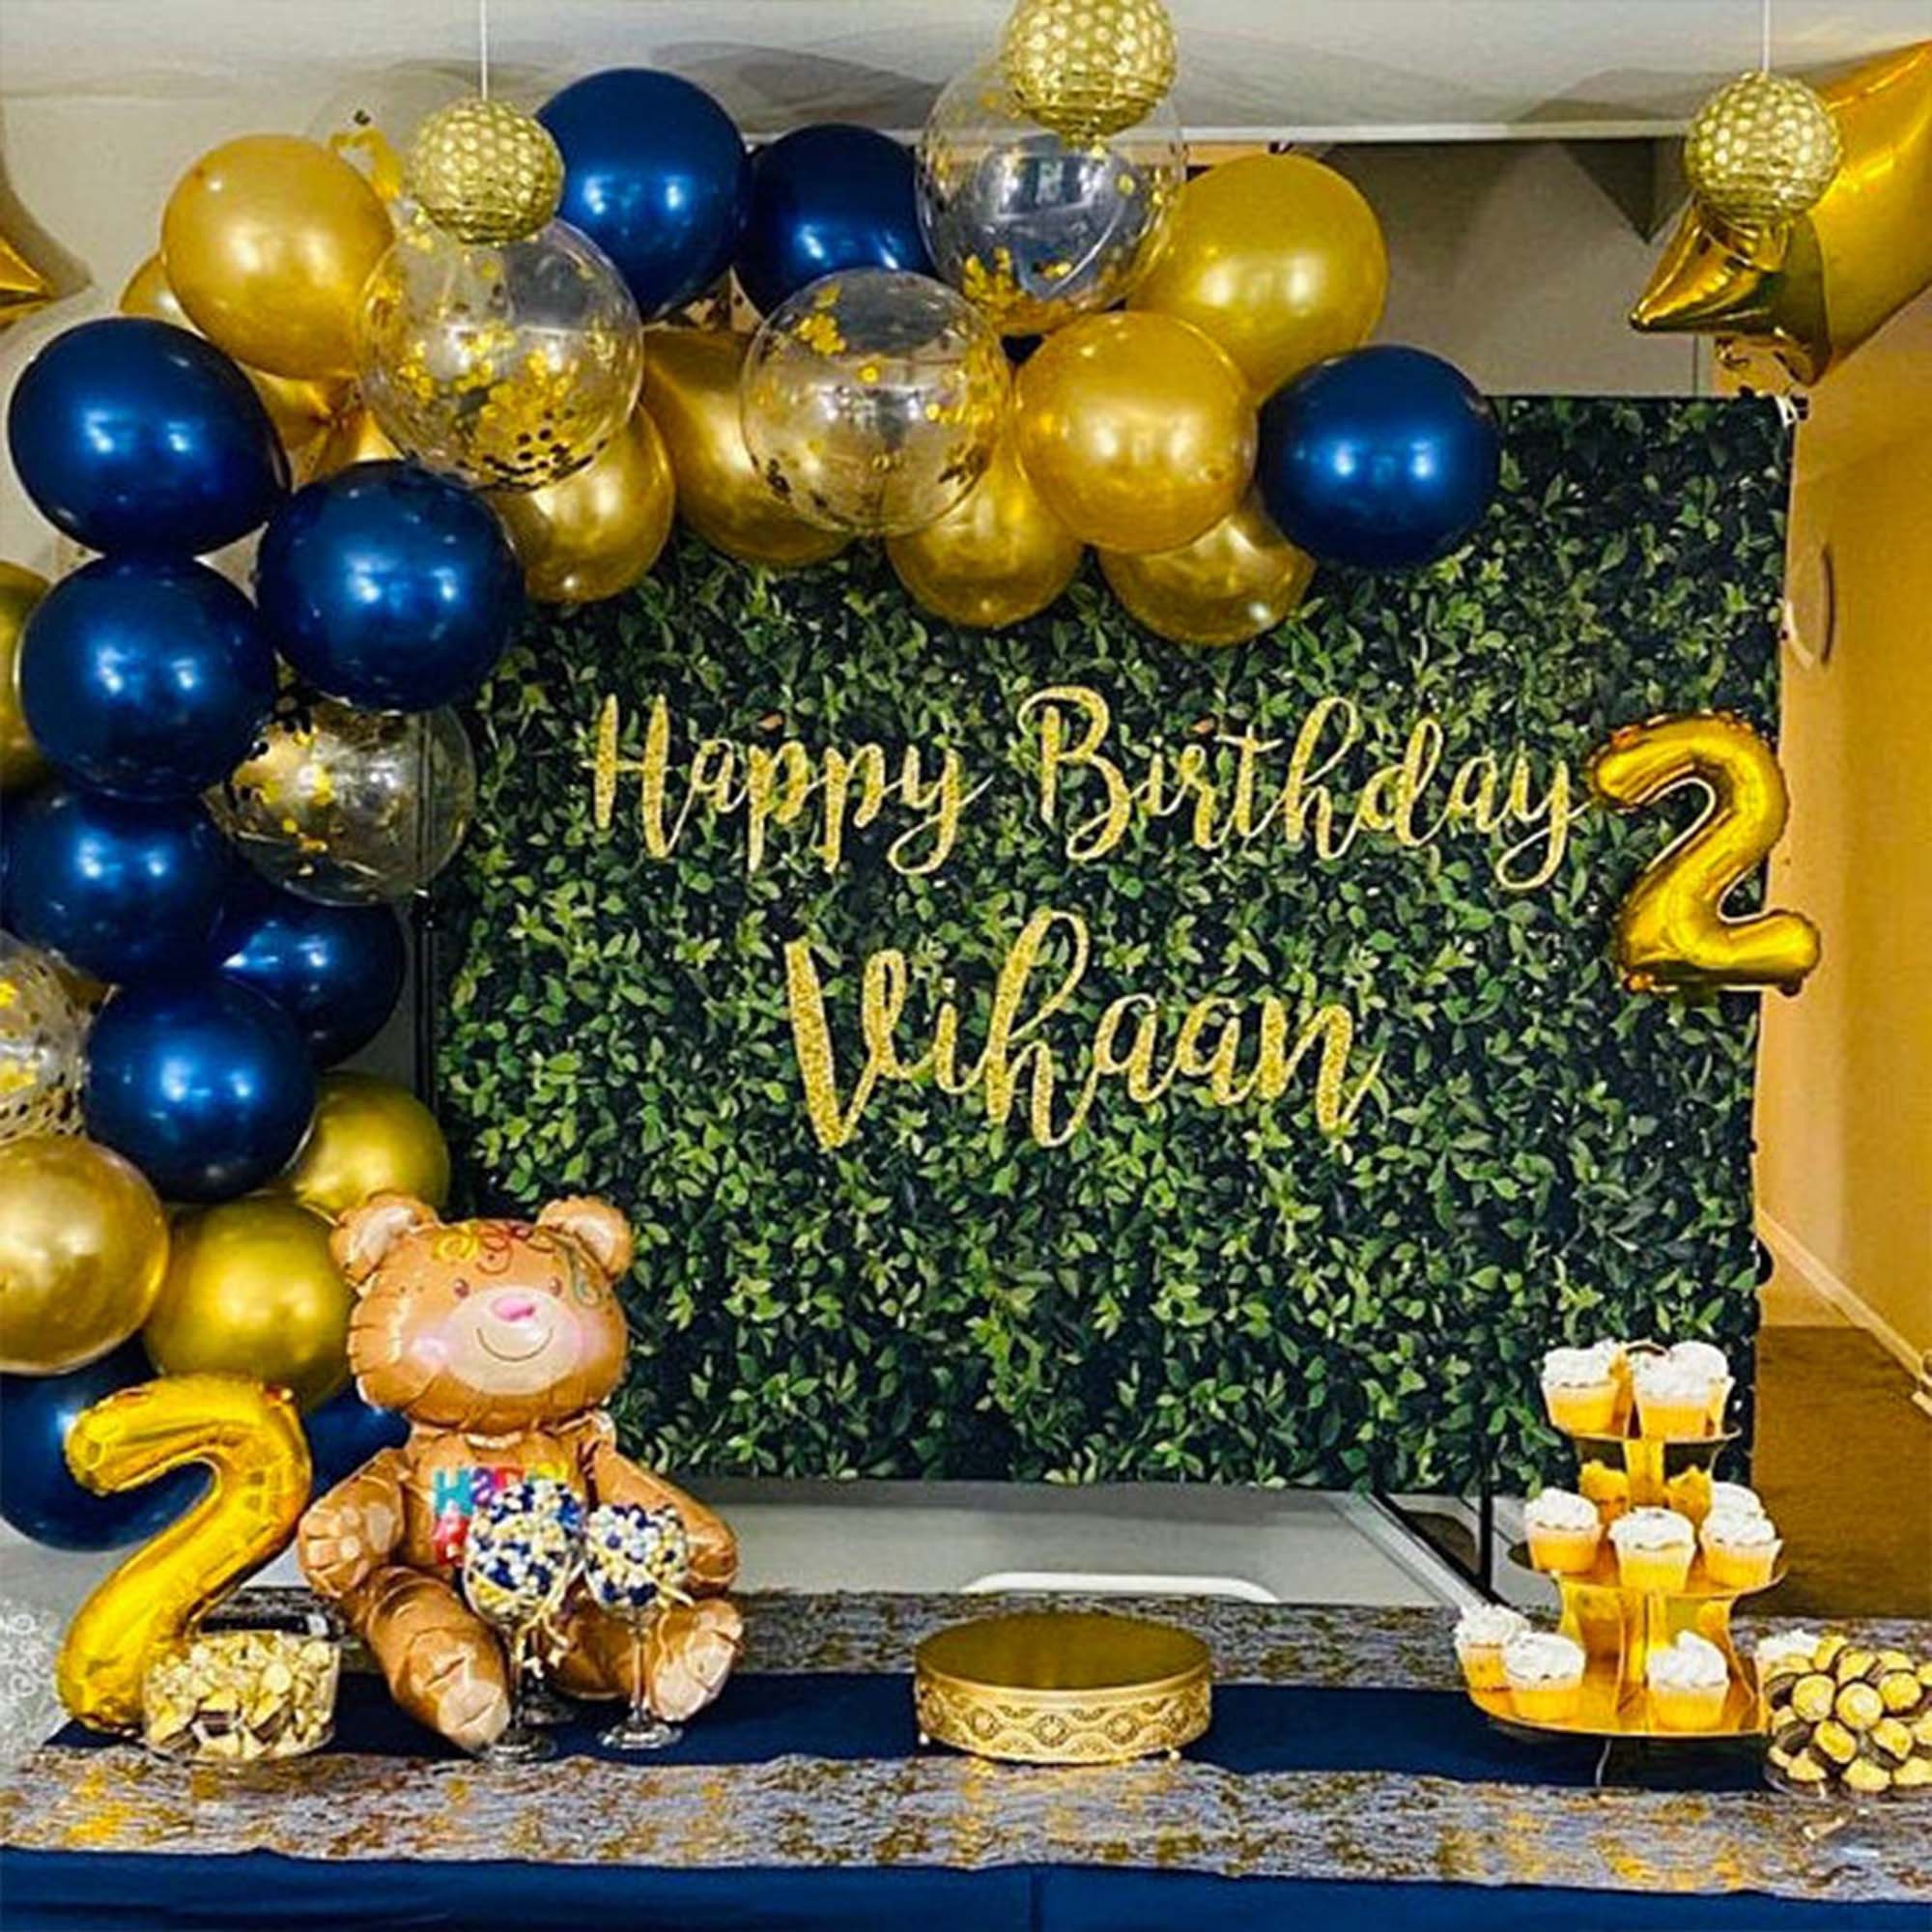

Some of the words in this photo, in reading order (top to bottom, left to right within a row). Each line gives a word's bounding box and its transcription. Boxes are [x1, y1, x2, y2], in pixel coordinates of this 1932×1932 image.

[581, 692, 994, 875] Happy
[1018, 685, 1591, 890] Birthday
[1592, 712, 1821, 994] 2
[784, 909, 1383, 1151] Vihaan
[58, 1374, 313, 1736] 2
